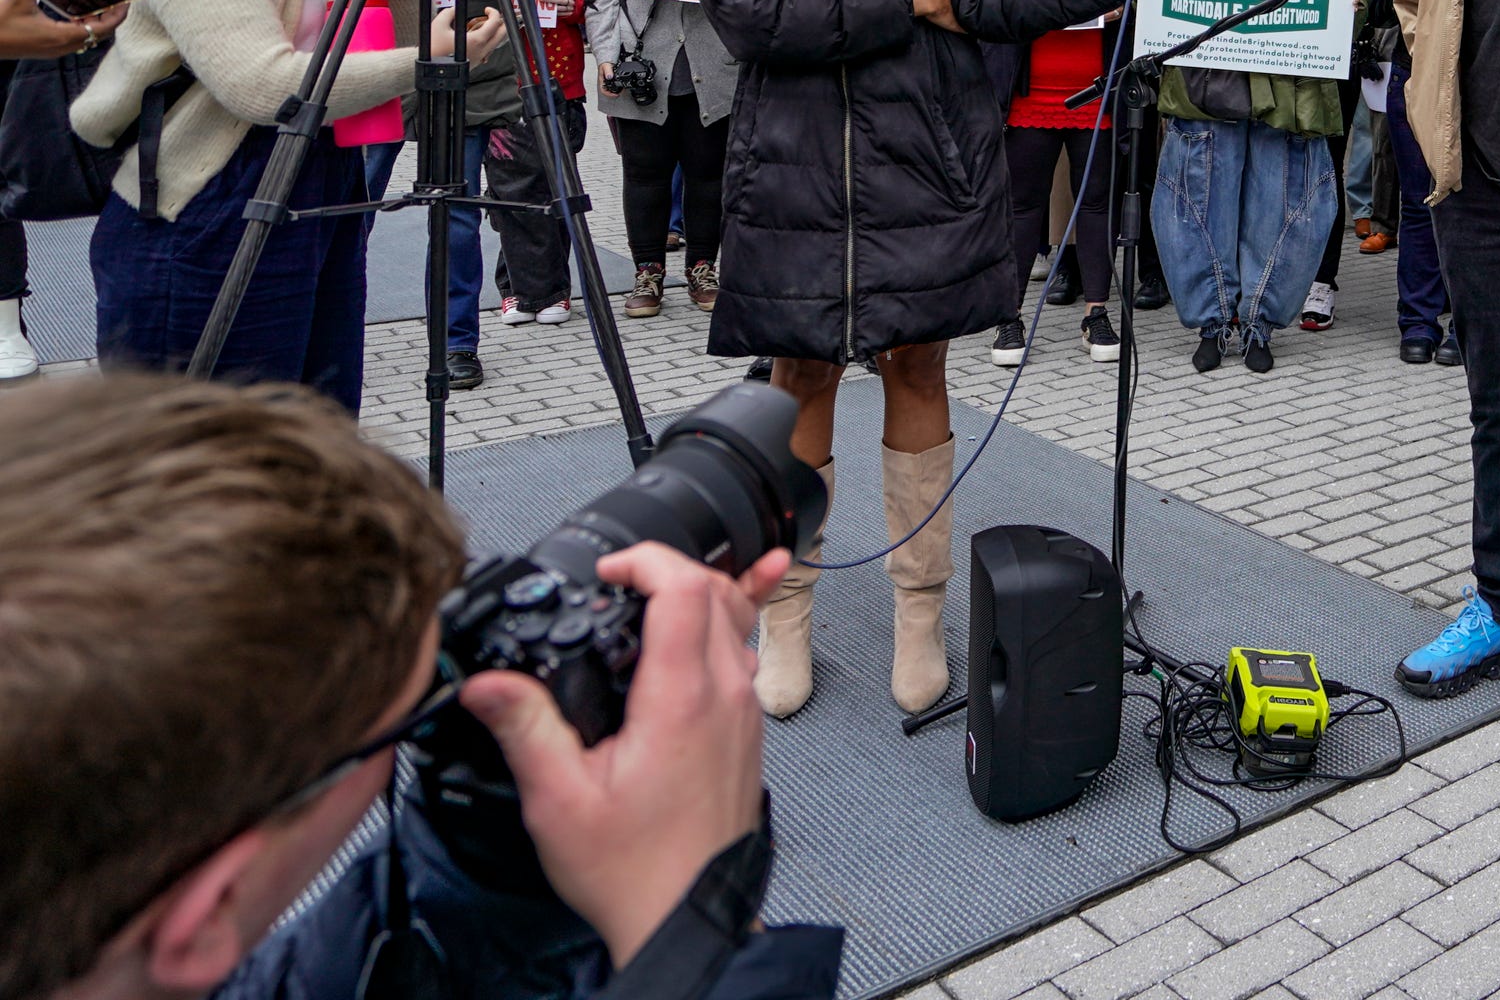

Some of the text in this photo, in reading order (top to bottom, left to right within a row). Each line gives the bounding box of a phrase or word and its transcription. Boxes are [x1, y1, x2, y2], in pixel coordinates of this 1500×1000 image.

[1247, 4, 1321, 26] BRIGHTWOOD
[1143, 39, 1342, 62] faceboom/protectmartindalebrightwood
[1167, 31, 1319, 51] ProtertindaleBrightwood.com
